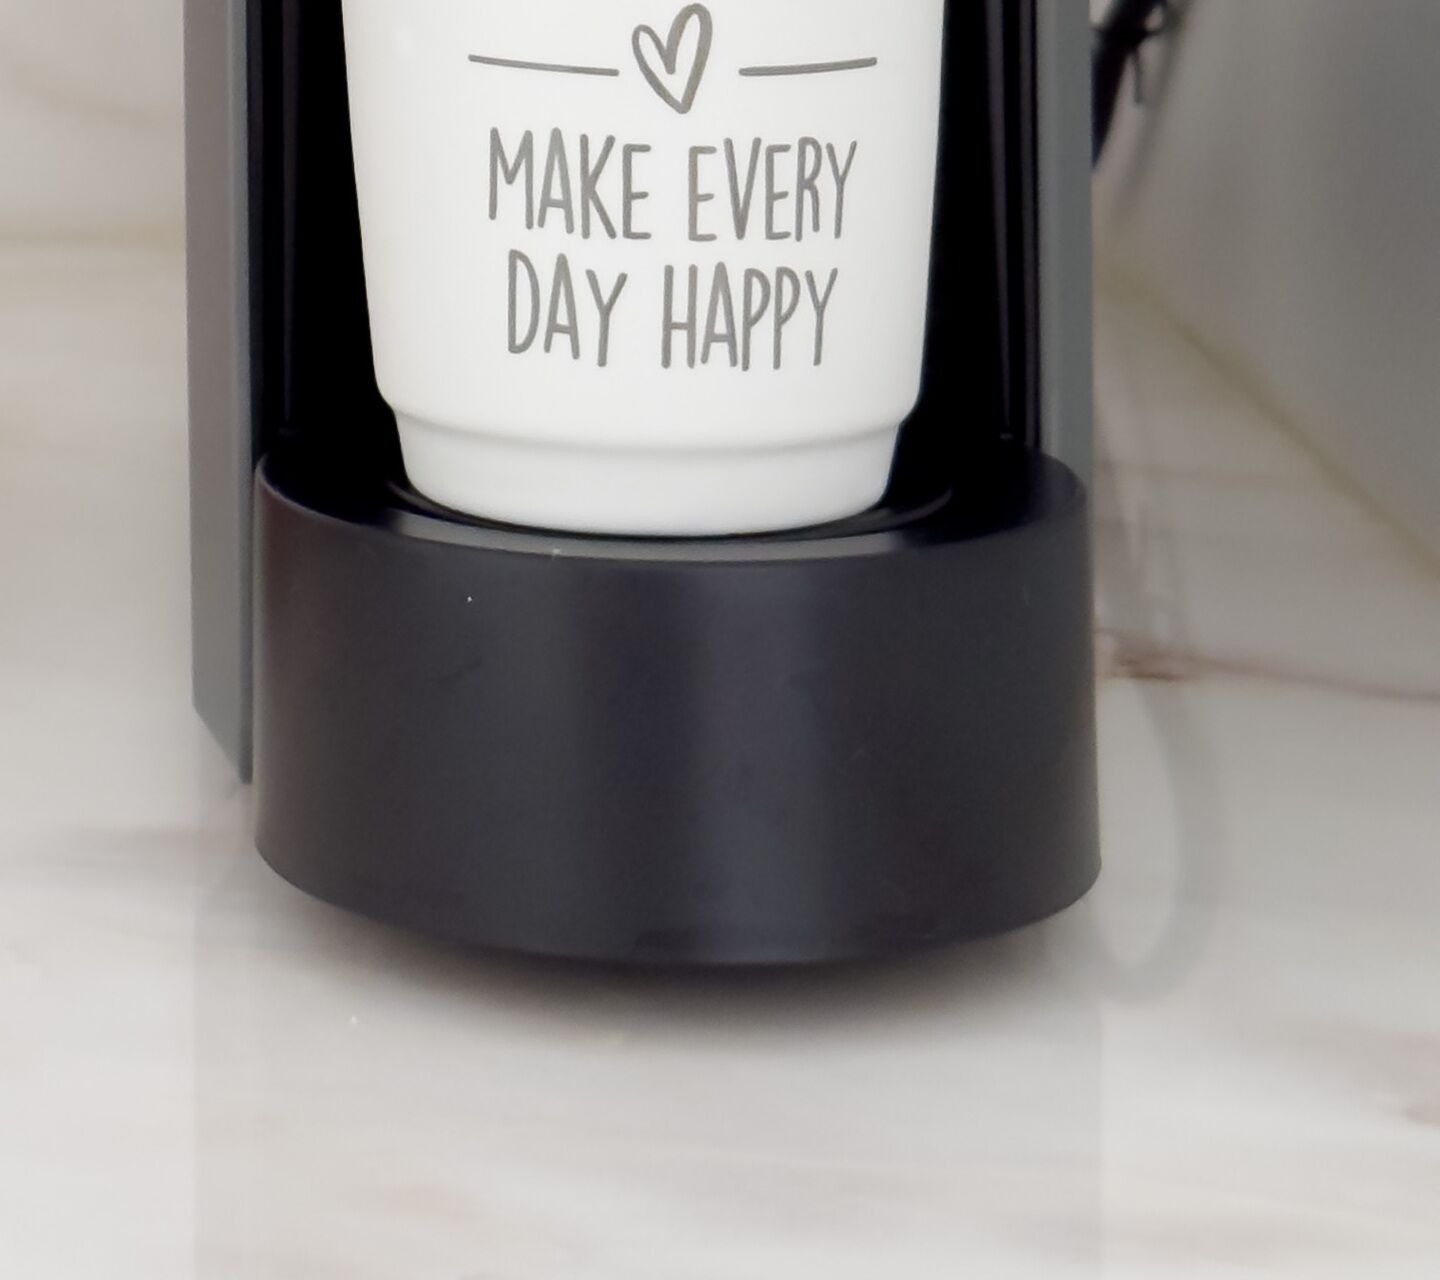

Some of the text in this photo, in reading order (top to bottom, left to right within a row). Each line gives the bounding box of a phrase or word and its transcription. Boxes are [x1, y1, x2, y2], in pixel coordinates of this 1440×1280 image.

[489, 128, 857, 242] MAKE EVERY
[508, 249, 838, 371] DAY HAPPY
